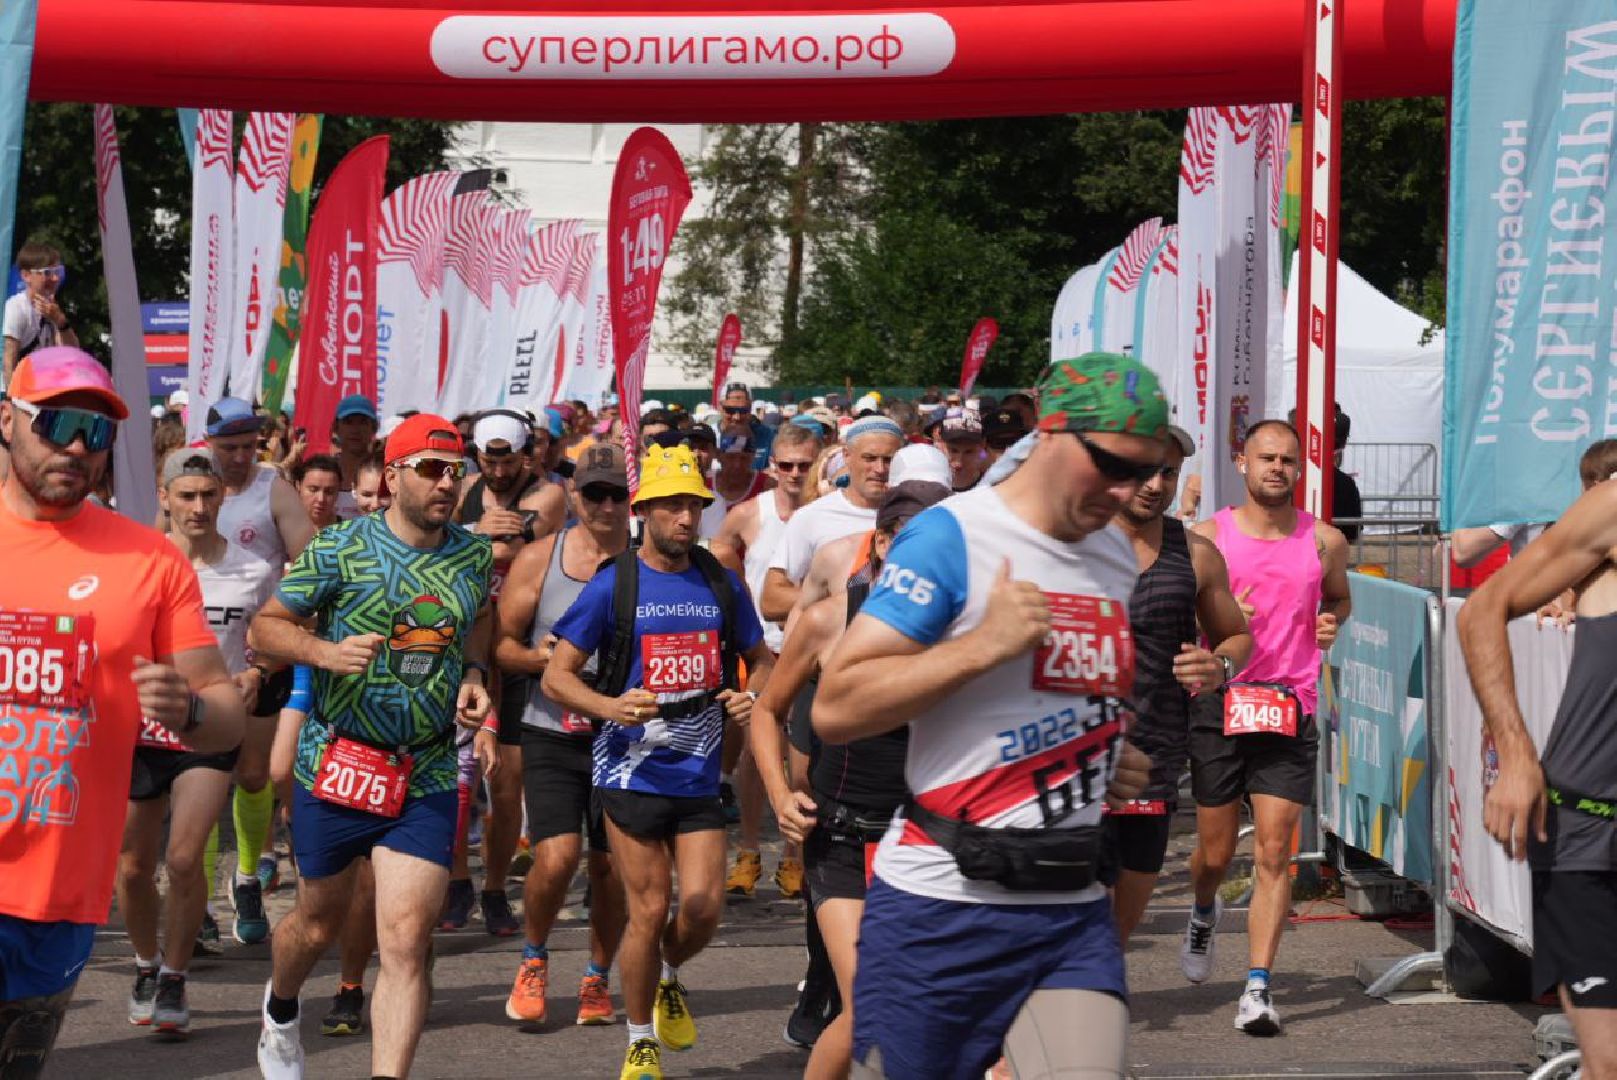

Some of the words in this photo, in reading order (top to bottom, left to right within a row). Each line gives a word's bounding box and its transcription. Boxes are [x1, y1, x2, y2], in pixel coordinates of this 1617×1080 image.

[482, 25, 904, 72] суперлигамо.рф
[621, 212, 665, 286] 1:49
[319, 251, 340, 386] Советский
[0, 647, 64, 694] 085
[649, 654, 705, 685] 2339
[1043, 629, 1118, 682] 2354
[996, 707, 1077, 762] 2022
[1229, 703, 1282, 728] 2049
[321, 760, 389, 806] 2075
